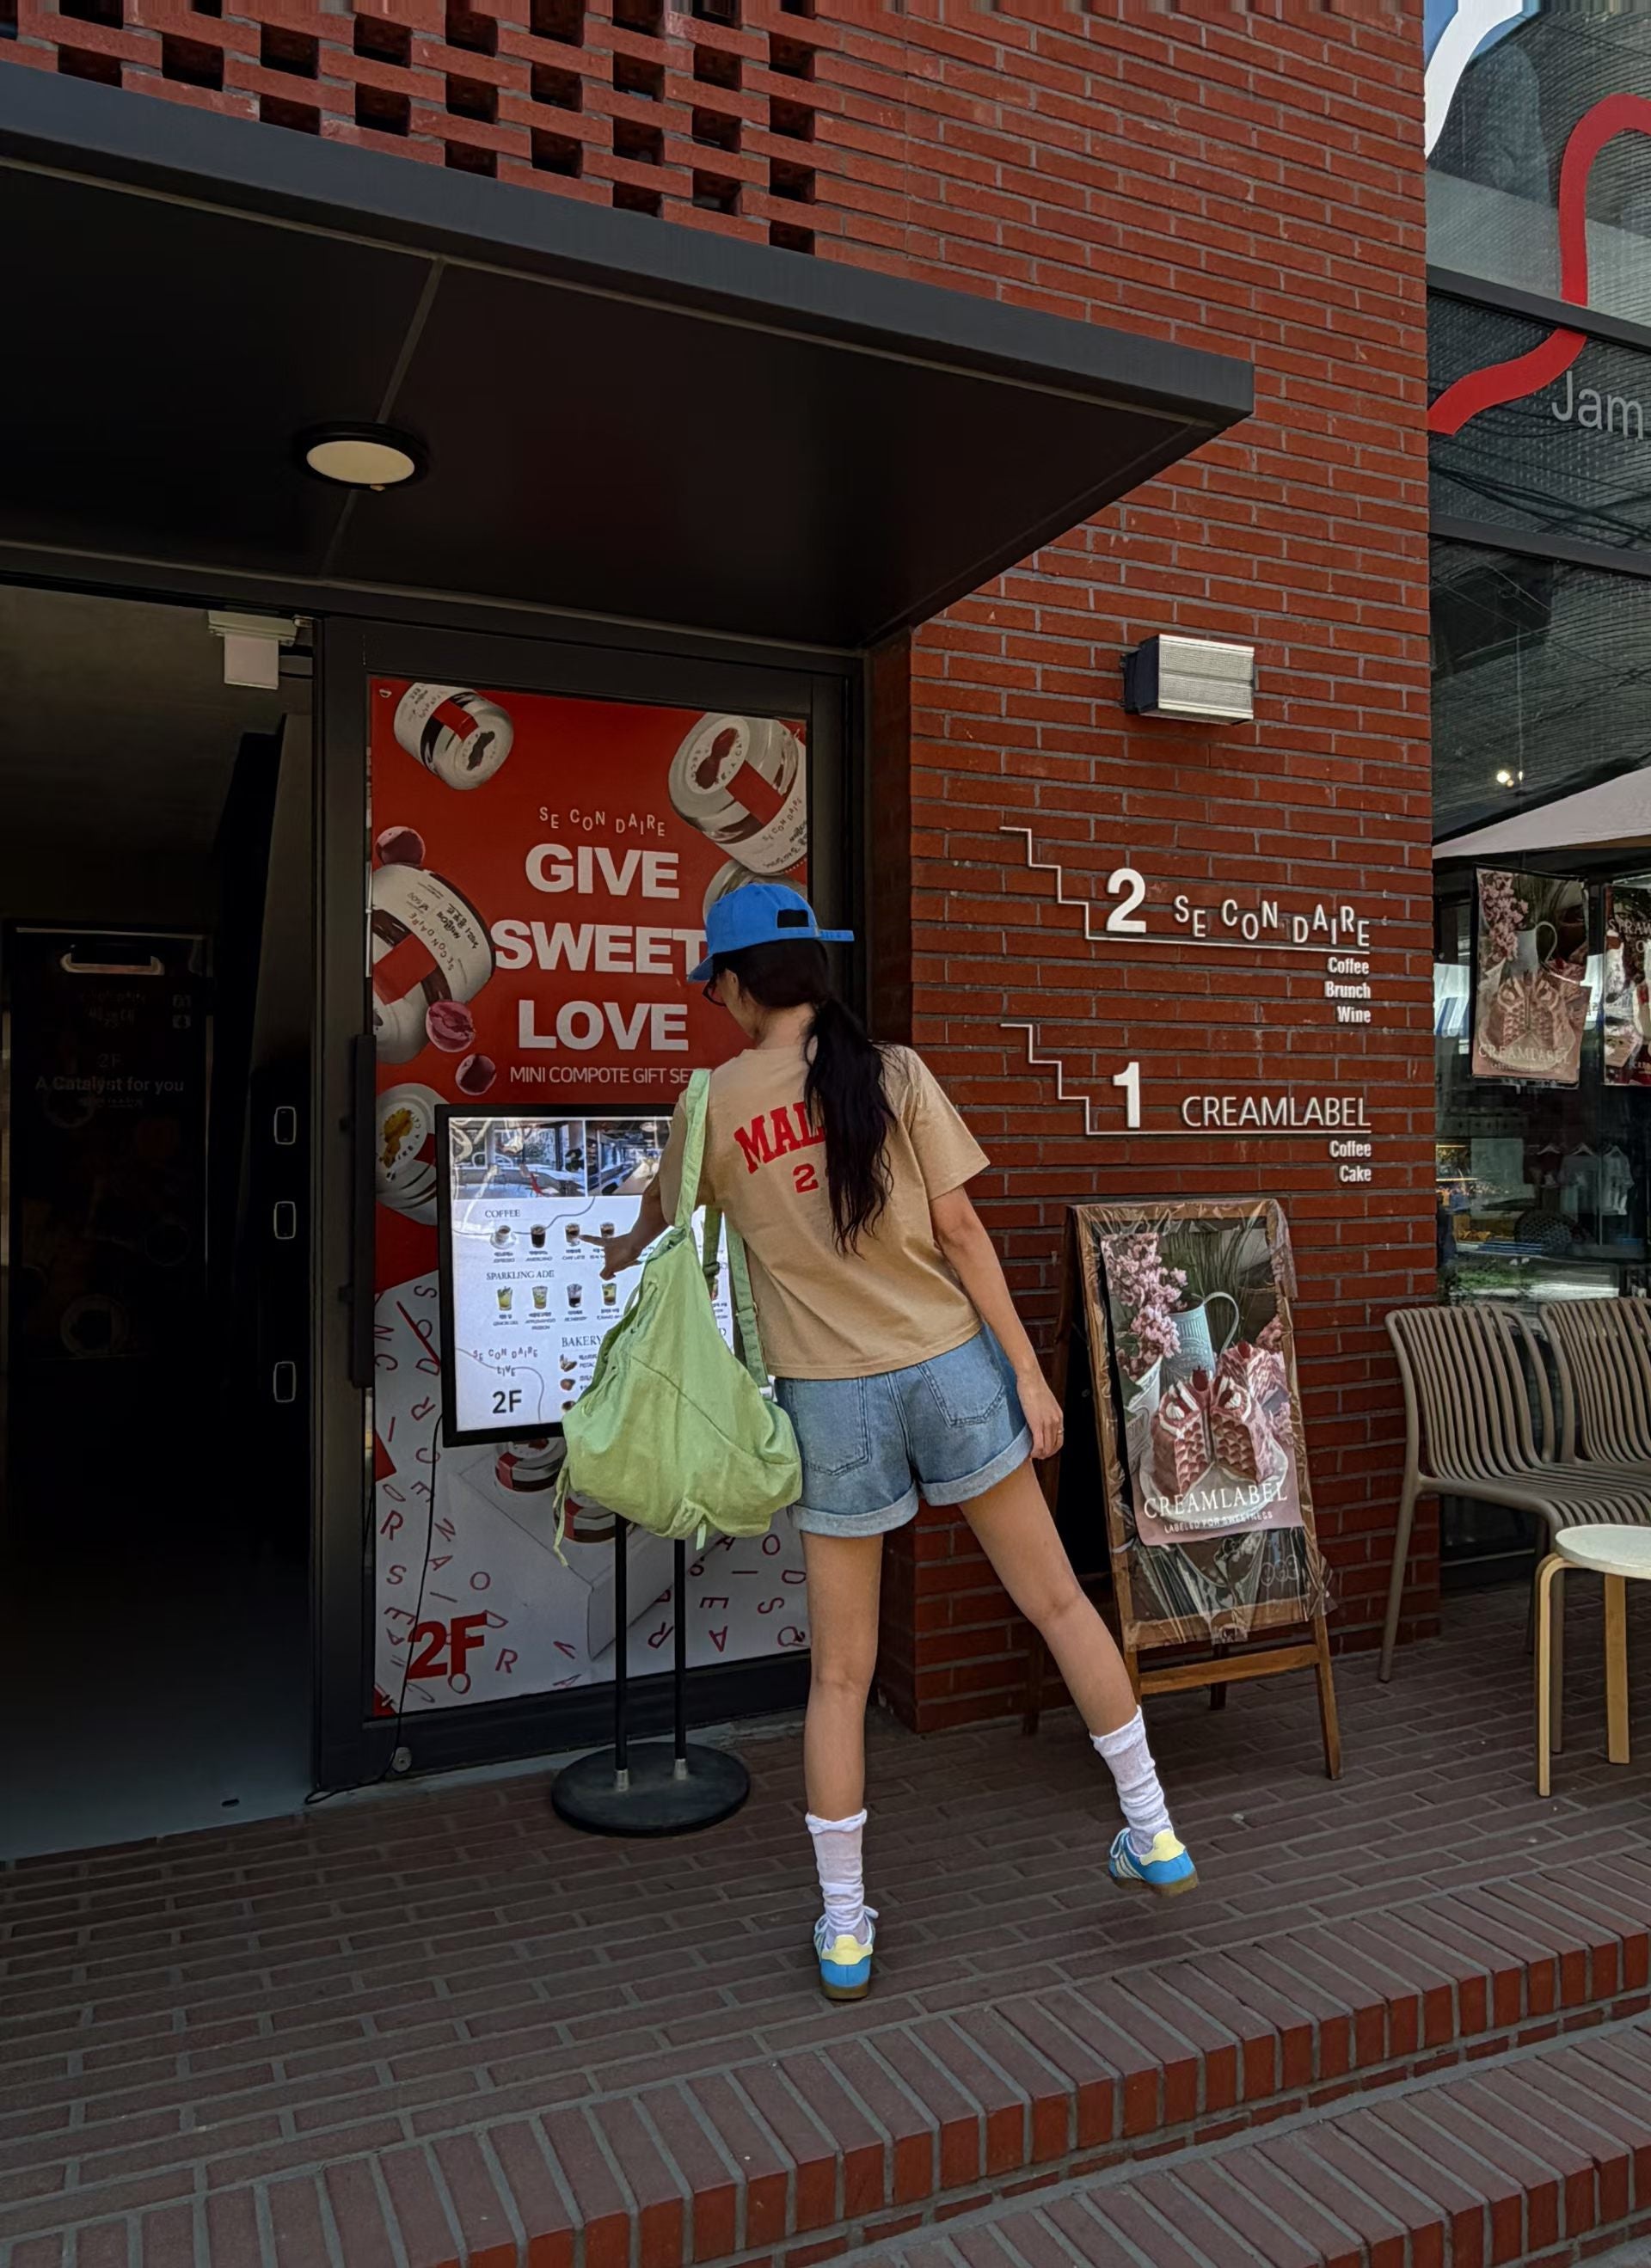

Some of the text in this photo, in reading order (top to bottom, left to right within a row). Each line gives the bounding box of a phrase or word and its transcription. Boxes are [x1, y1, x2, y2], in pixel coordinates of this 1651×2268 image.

[1551, 371, 1643, 440] Jam
[569, 809, 605, 831] CON
[616, 812, 666, 837] DAIRE
[525, 843, 679, 898] GIVE
[1106, 867, 1370, 947] 2 SE CON DAIRE
[490, 920, 708, 975] SWEET
[1327, 957, 1370, 975] Coffee
[1325, 981, 1371, 999] Brunch
[519, 1000, 689, 1051] LOVE
[1337, 1006, 1371, 1023] Wine
[126, 1075, 150, 1091] for
[154, 1080, 185, 1095] you
[510, 1066, 546, 1083] MINI
[549, 1066, 629, 1084] COMPOTE
[633, 1067, 667, 1084] GIFT
[1113, 1062, 1372, 1128] 1 CREAMLABEL
[1329, 1140, 1372, 1158] Coffee
[793, 1162, 822, 1193] 2
[1339, 1166, 1372, 1182] Cake
[485, 1209, 521, 1218] COFFEE
[486, 1270, 555, 1280] SPARKLING ADE
[492, 1389, 522, 1414] 2F
[1144, 1480, 1288, 1519] CREAMLABEL
[407, 1610, 488, 1680] 2F
